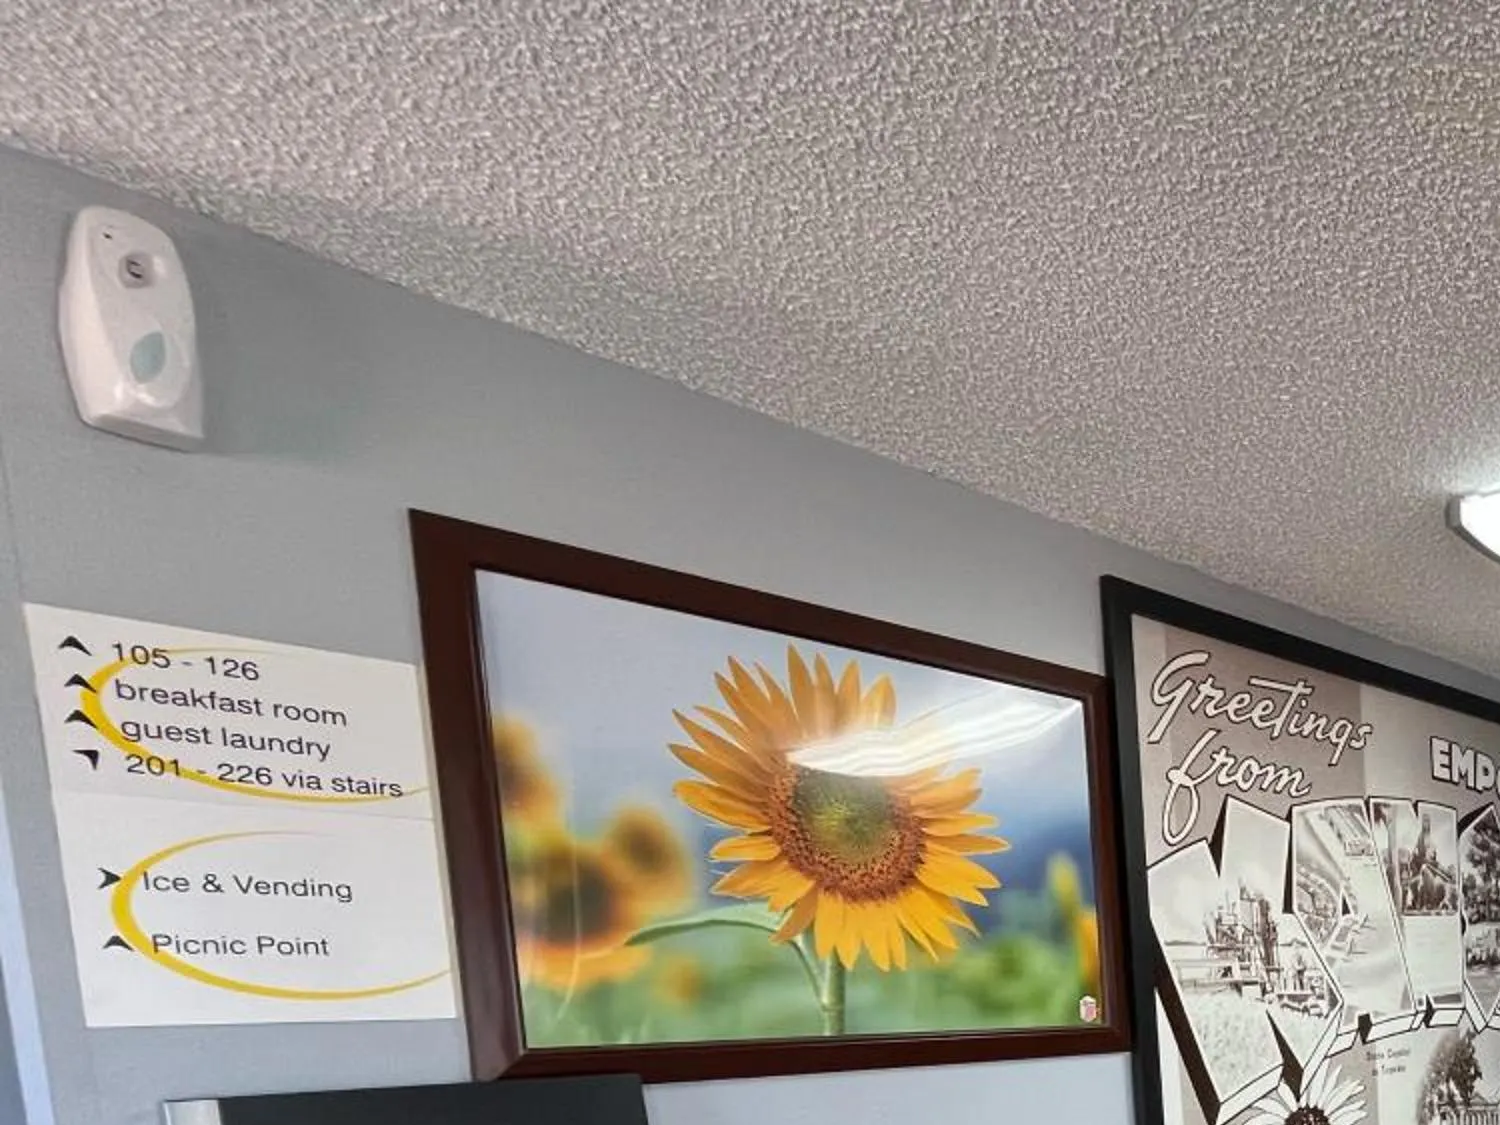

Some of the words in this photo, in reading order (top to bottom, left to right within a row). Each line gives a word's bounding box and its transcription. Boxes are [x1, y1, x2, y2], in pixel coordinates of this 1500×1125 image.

[111, 642, 171, 669] 105
[207, 656, 260, 681] 126
[115, 678, 262, 718] breakfast
[272, 702, 347, 728] room
[1146, 650, 1373, 767] Greetings
[120, 719, 213, 744] guest
[221, 727, 332, 763] laundry
[126, 753, 182, 778] 201
[218, 762, 273, 787] 226
[281, 770, 322, 792] via
[331, 774, 403, 799] stairs
[1161, 730, 1314, 847] from
[142, 872, 191, 894] Ice
[202, 874, 225, 895] &
[233, 874, 354, 904] Vending
[151, 933, 247, 957] Picnic
[257, 935, 331, 958] Point
